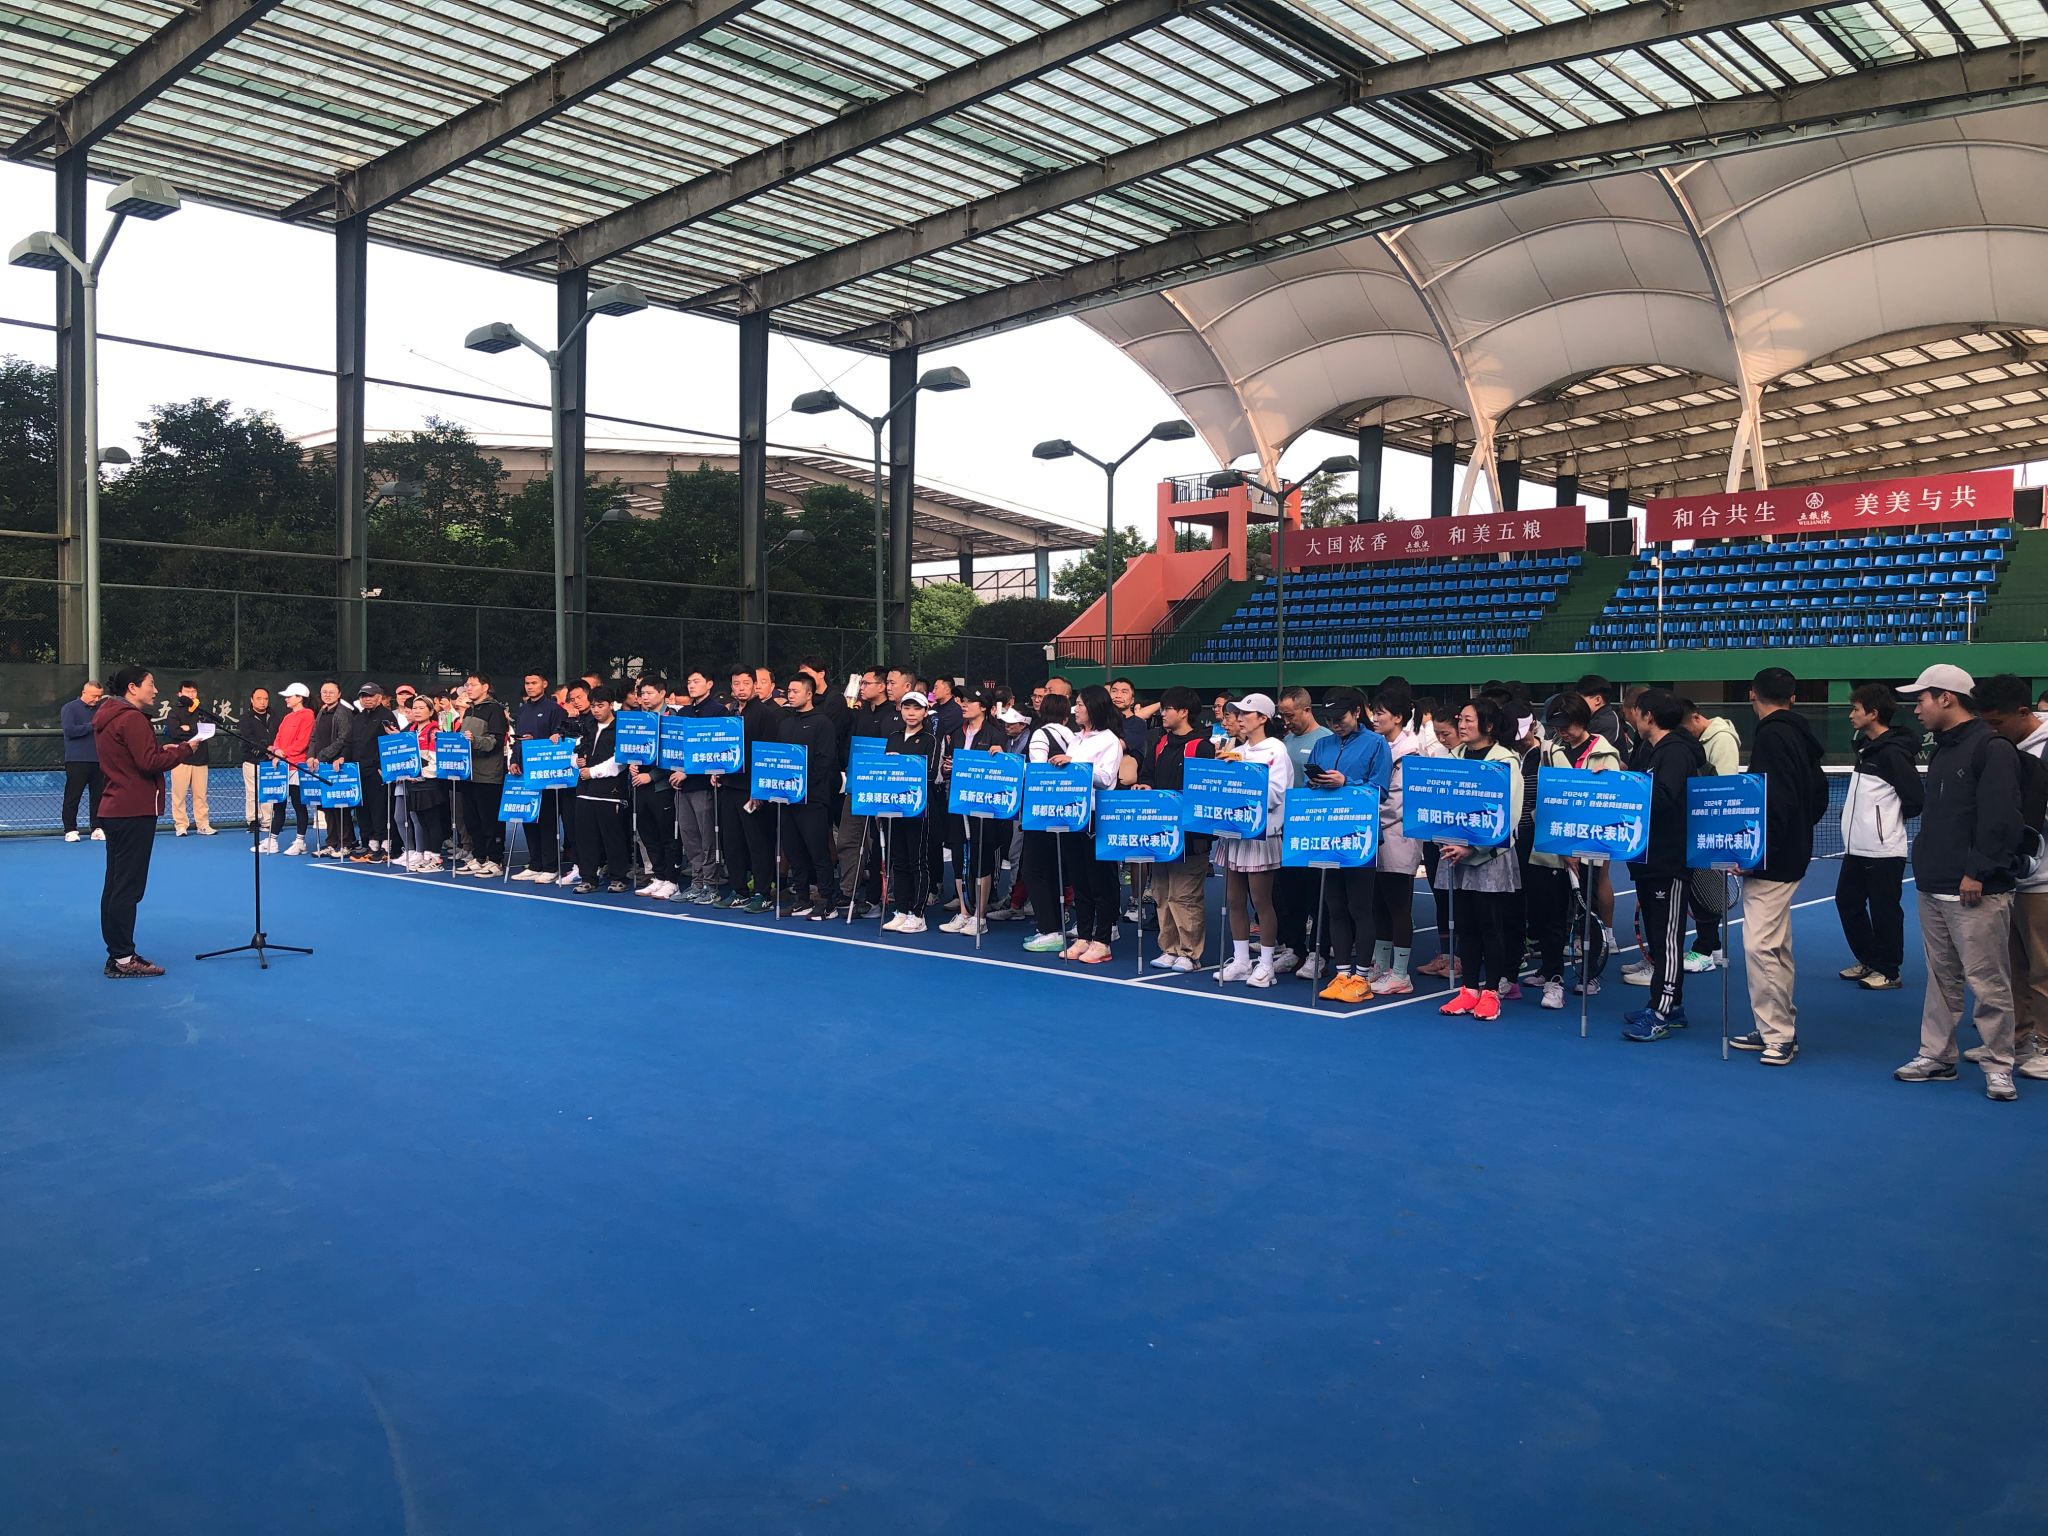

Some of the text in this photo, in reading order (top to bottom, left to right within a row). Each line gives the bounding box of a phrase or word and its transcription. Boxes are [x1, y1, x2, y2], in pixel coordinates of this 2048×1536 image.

[1672, 485, 1977, 529] 和合共生 美美与共
[1305, 520, 1542, 557] 大国浓香 和美五粮
[691, 751, 735, 763] 成华区代表队
[529, 767, 574, 780] 武侯区代表2队
[758, 777, 798, 791] 新津区代表队
[857, 791, 916, 805] 龙泉驿区代表队
[959, 789, 1010, 806] 高新区代表队
[1031, 803, 1081, 818] 郫都区代表队
[1193, 804, 1254, 824] 温江区代表队
[1416, 807, 1495, 829] 简阳市代表队
[1549, 820, 1631, 842] 新都区代表队
[1107, 833, 1172, 848] 双流区代表队
[1290, 834, 1363, 851] 青白江区代表队
[1696, 831, 1754, 850] 崇州市代表队
